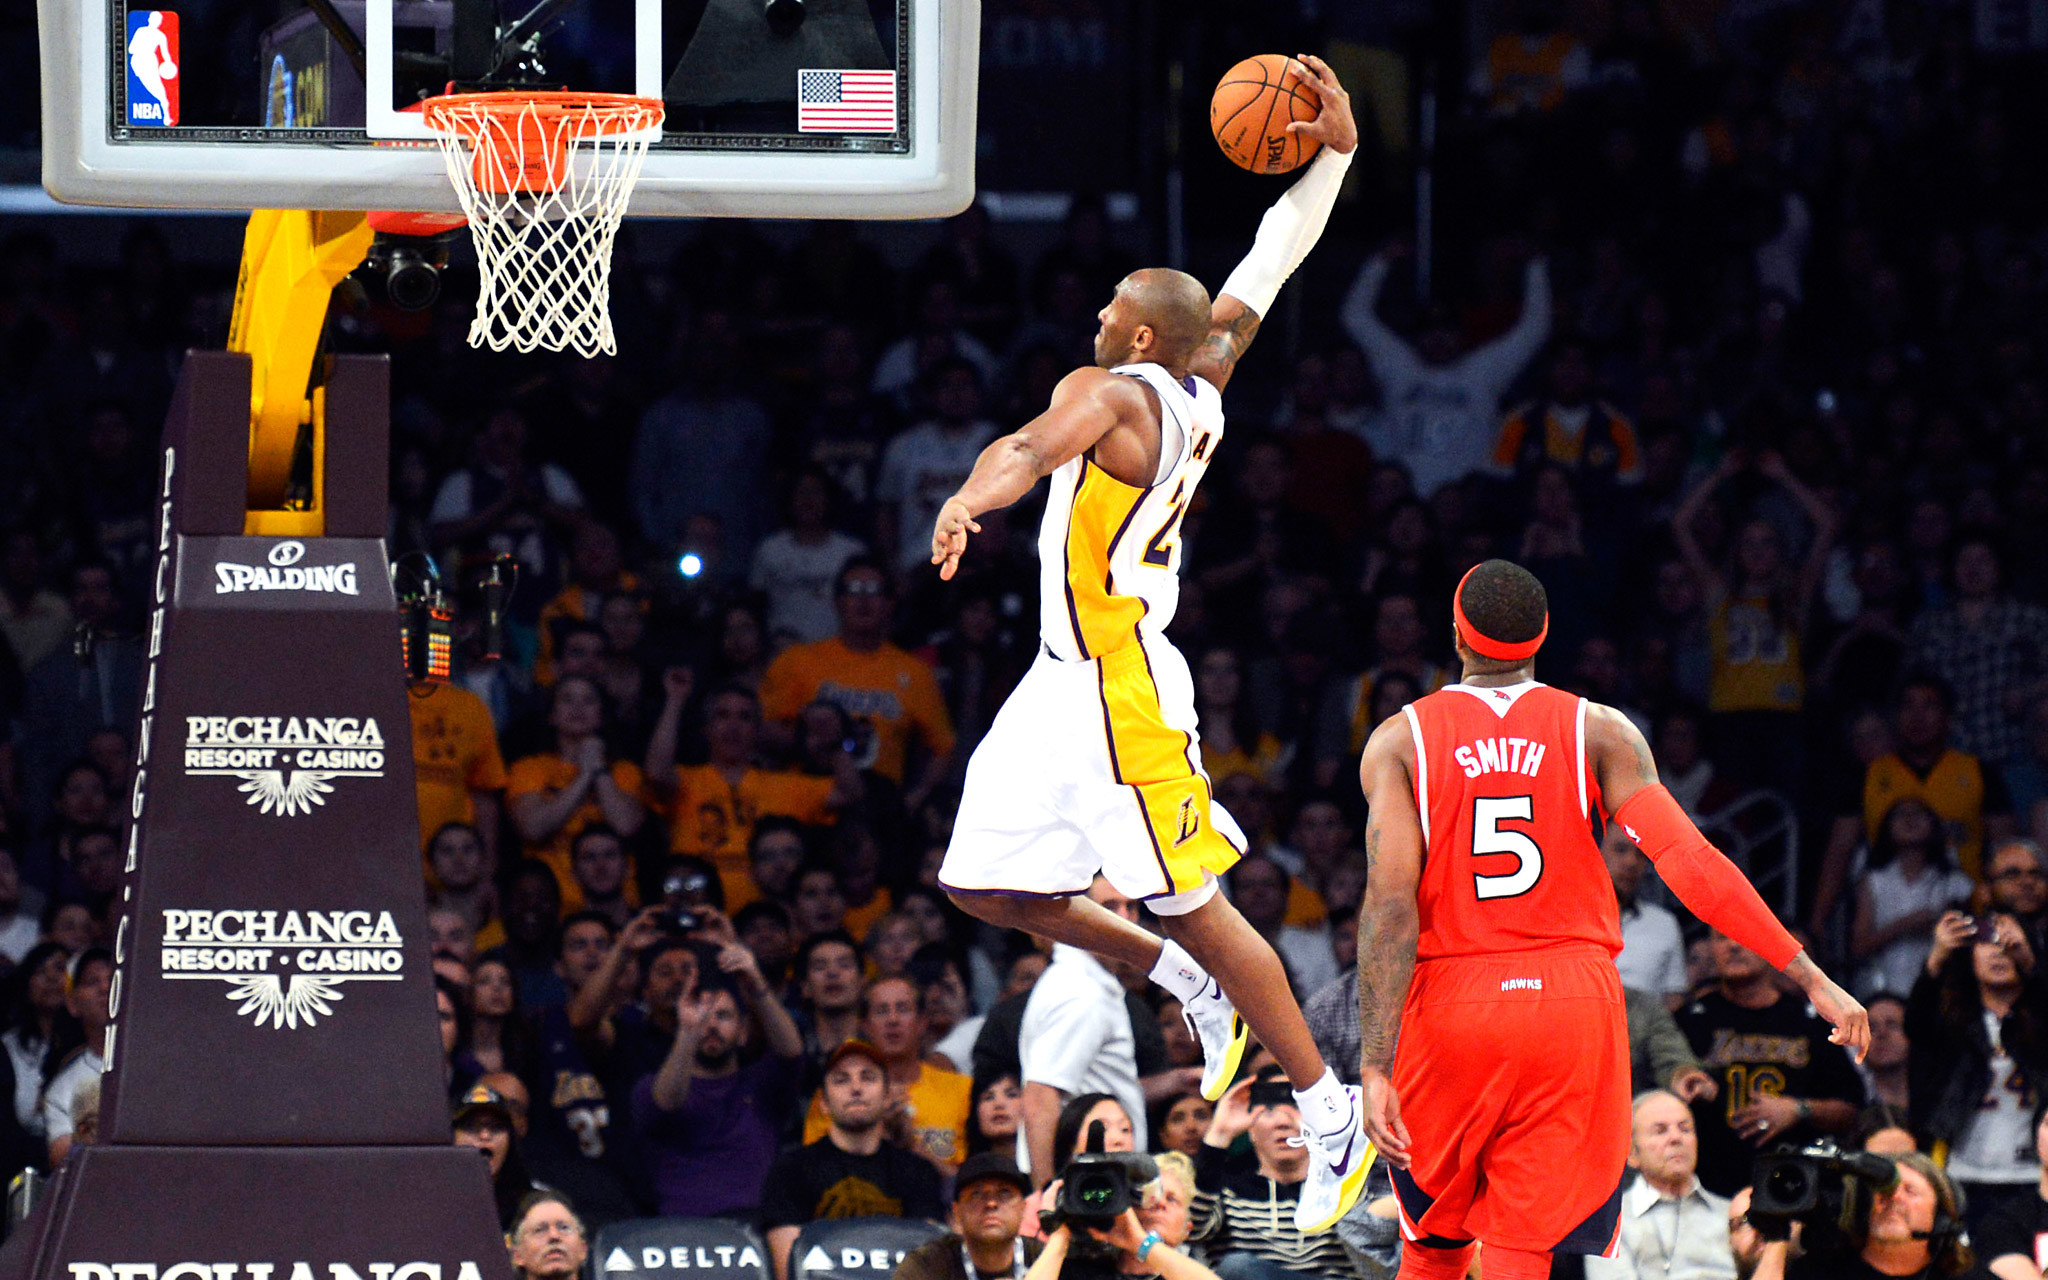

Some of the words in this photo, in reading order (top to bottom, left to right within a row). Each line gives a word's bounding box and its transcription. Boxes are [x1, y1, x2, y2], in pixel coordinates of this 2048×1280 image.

[132, 102, 163, 119] NBA
[214, 561, 360, 596] SPALDING
[186, 716, 385, 746] PECHANGA
[184, 749, 277, 768] RESORT
[296, 750, 385, 769] CASINO
[1454, 737, 1546, 779] SMITH
[1470, 793, 1545, 902] 5
[162, 909, 403, 943] PECHANGA
[161, 949, 273, 971] RESORT
[296, 949, 404, 972] CASINO
[1501, 978, 1543, 992] HAWKS
[642, 1246, 762, 1269] DELTA
